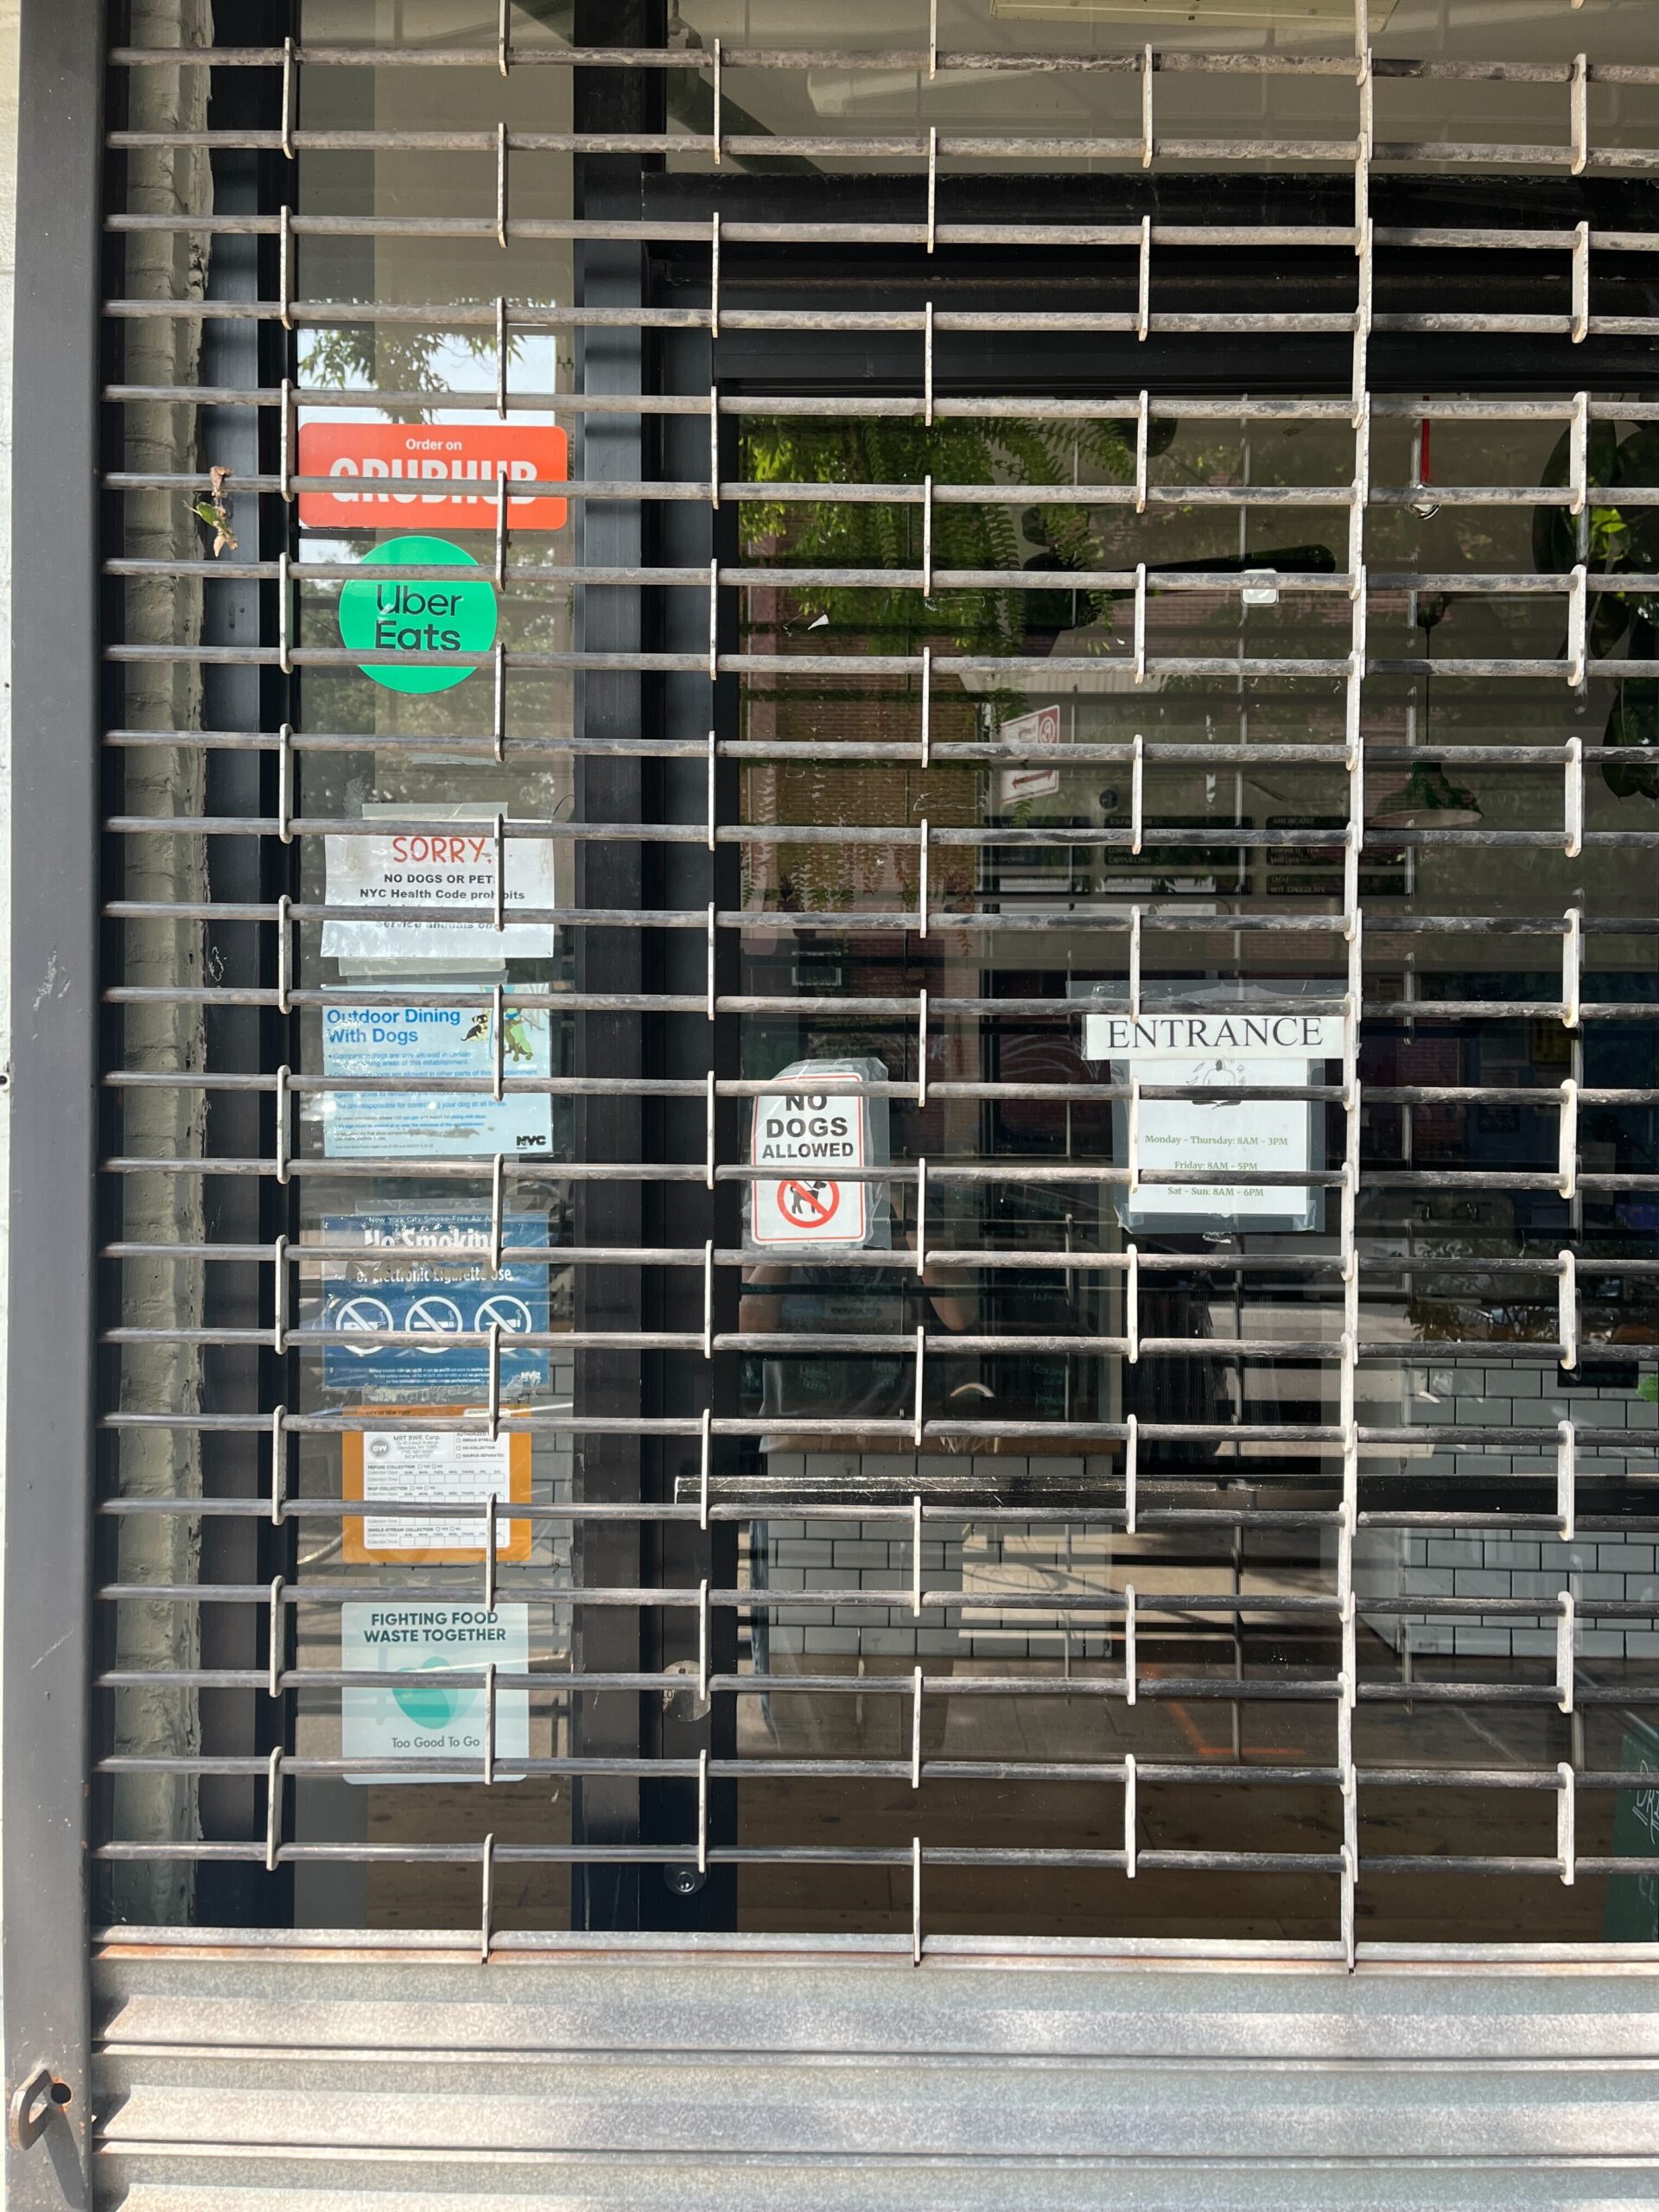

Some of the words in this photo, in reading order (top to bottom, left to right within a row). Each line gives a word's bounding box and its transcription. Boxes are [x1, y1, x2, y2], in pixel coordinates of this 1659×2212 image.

[405, 438, 442, 450] Order
[445, 441, 462, 450] on
[377, 584, 464, 616] Uber
[375, 620, 461, 651] Eats
[384, 874, 403, 883] NO
[407, 874, 442, 883] DOGS
[447, 874, 465, 884] OR
[468, 874, 495, 884] PET
[360, 888, 387, 898] NYC
[391, 889, 431, 899] Health
[435, 889, 467, 899] Code
[470, 890, 525, 901] proits
[327, 1008, 399, 1024] Outdoor
[405, 1008, 461, 1026] Dining
[327, 1027, 366, 1043] With
[372, 1027, 418, 1046] Dogs
[1106, 1016, 1324, 1049] ENTRANCE
[785, 1095, 828, 1111] NO
[766, 1116, 848, 1139] DOGS
[516, 1135, 546, 1147] NYC
[1144, 1135, 1182, 1146] Monday
[1190, 1135, 1236, 1147] Thursday:
[1268, 1137, 1288, 1146] 3PM
[761, 1142, 854, 1159] ALLOWED
[1174, 1160, 1206, 1170] Friday:
[1207, 1161, 1229, 1170] 8AM
[1237, 1162, 1258, 1171] 5PM
[1167, 1186, 1183, 1195] Sat
[1191, 1187, 1211, 1196] Sun:
[1243, 1188, 1264, 1197] 6PM
[406, 1216, 422, 1224] City
[364, 1229, 395, 1247] No
[400, 1228, 504, 1248] Smokin
[371, 1611, 448, 1626] FIGHTING
[451, 1611, 499, 1625] FOOD
[364, 1629, 419, 1643] WASTE
[422, 1628, 506, 1642] TOGETHER
[391, 1737, 410, 1749] Too
[414, 1735, 445, 1748] Good
[448, 1736, 460, 1747] To
[463, 1735, 480, 1747] Go
